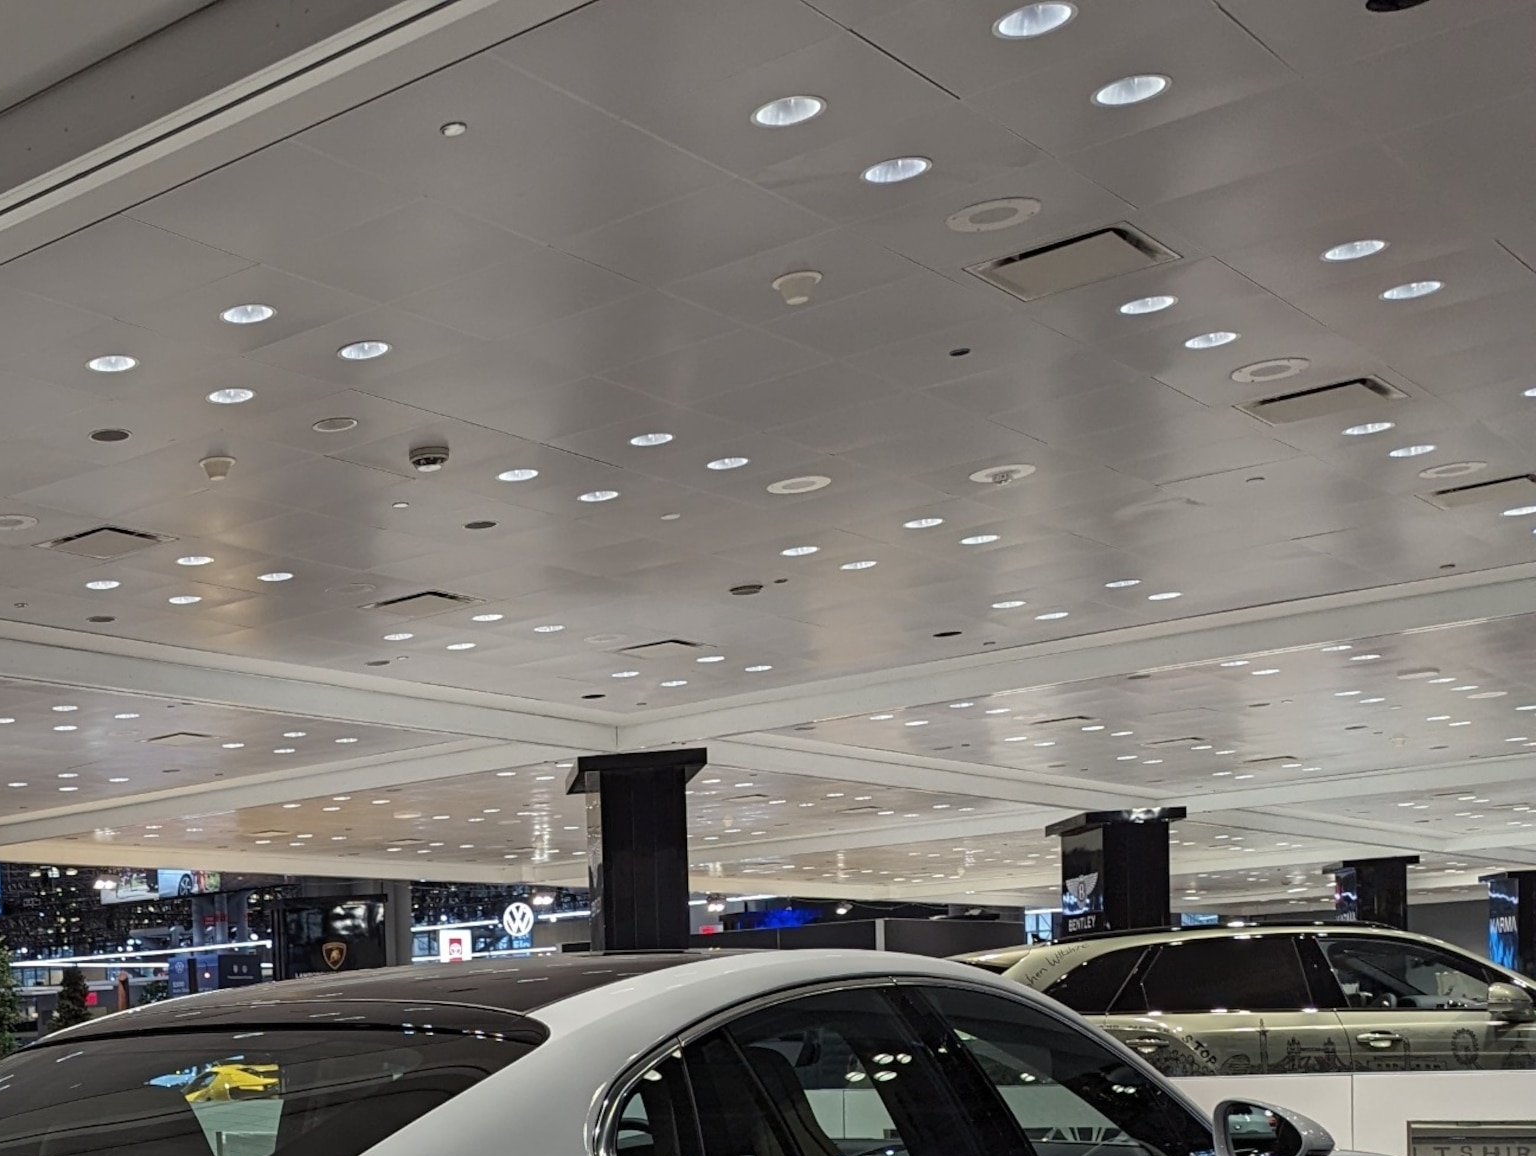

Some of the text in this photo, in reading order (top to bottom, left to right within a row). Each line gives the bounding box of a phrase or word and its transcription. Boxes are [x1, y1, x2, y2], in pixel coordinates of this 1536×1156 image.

[1068, 914, 1096, 932] BENTLEY
[1490, 915, 1518, 933] KARMA
[1181, 1034, 1217, 1064] STOP
